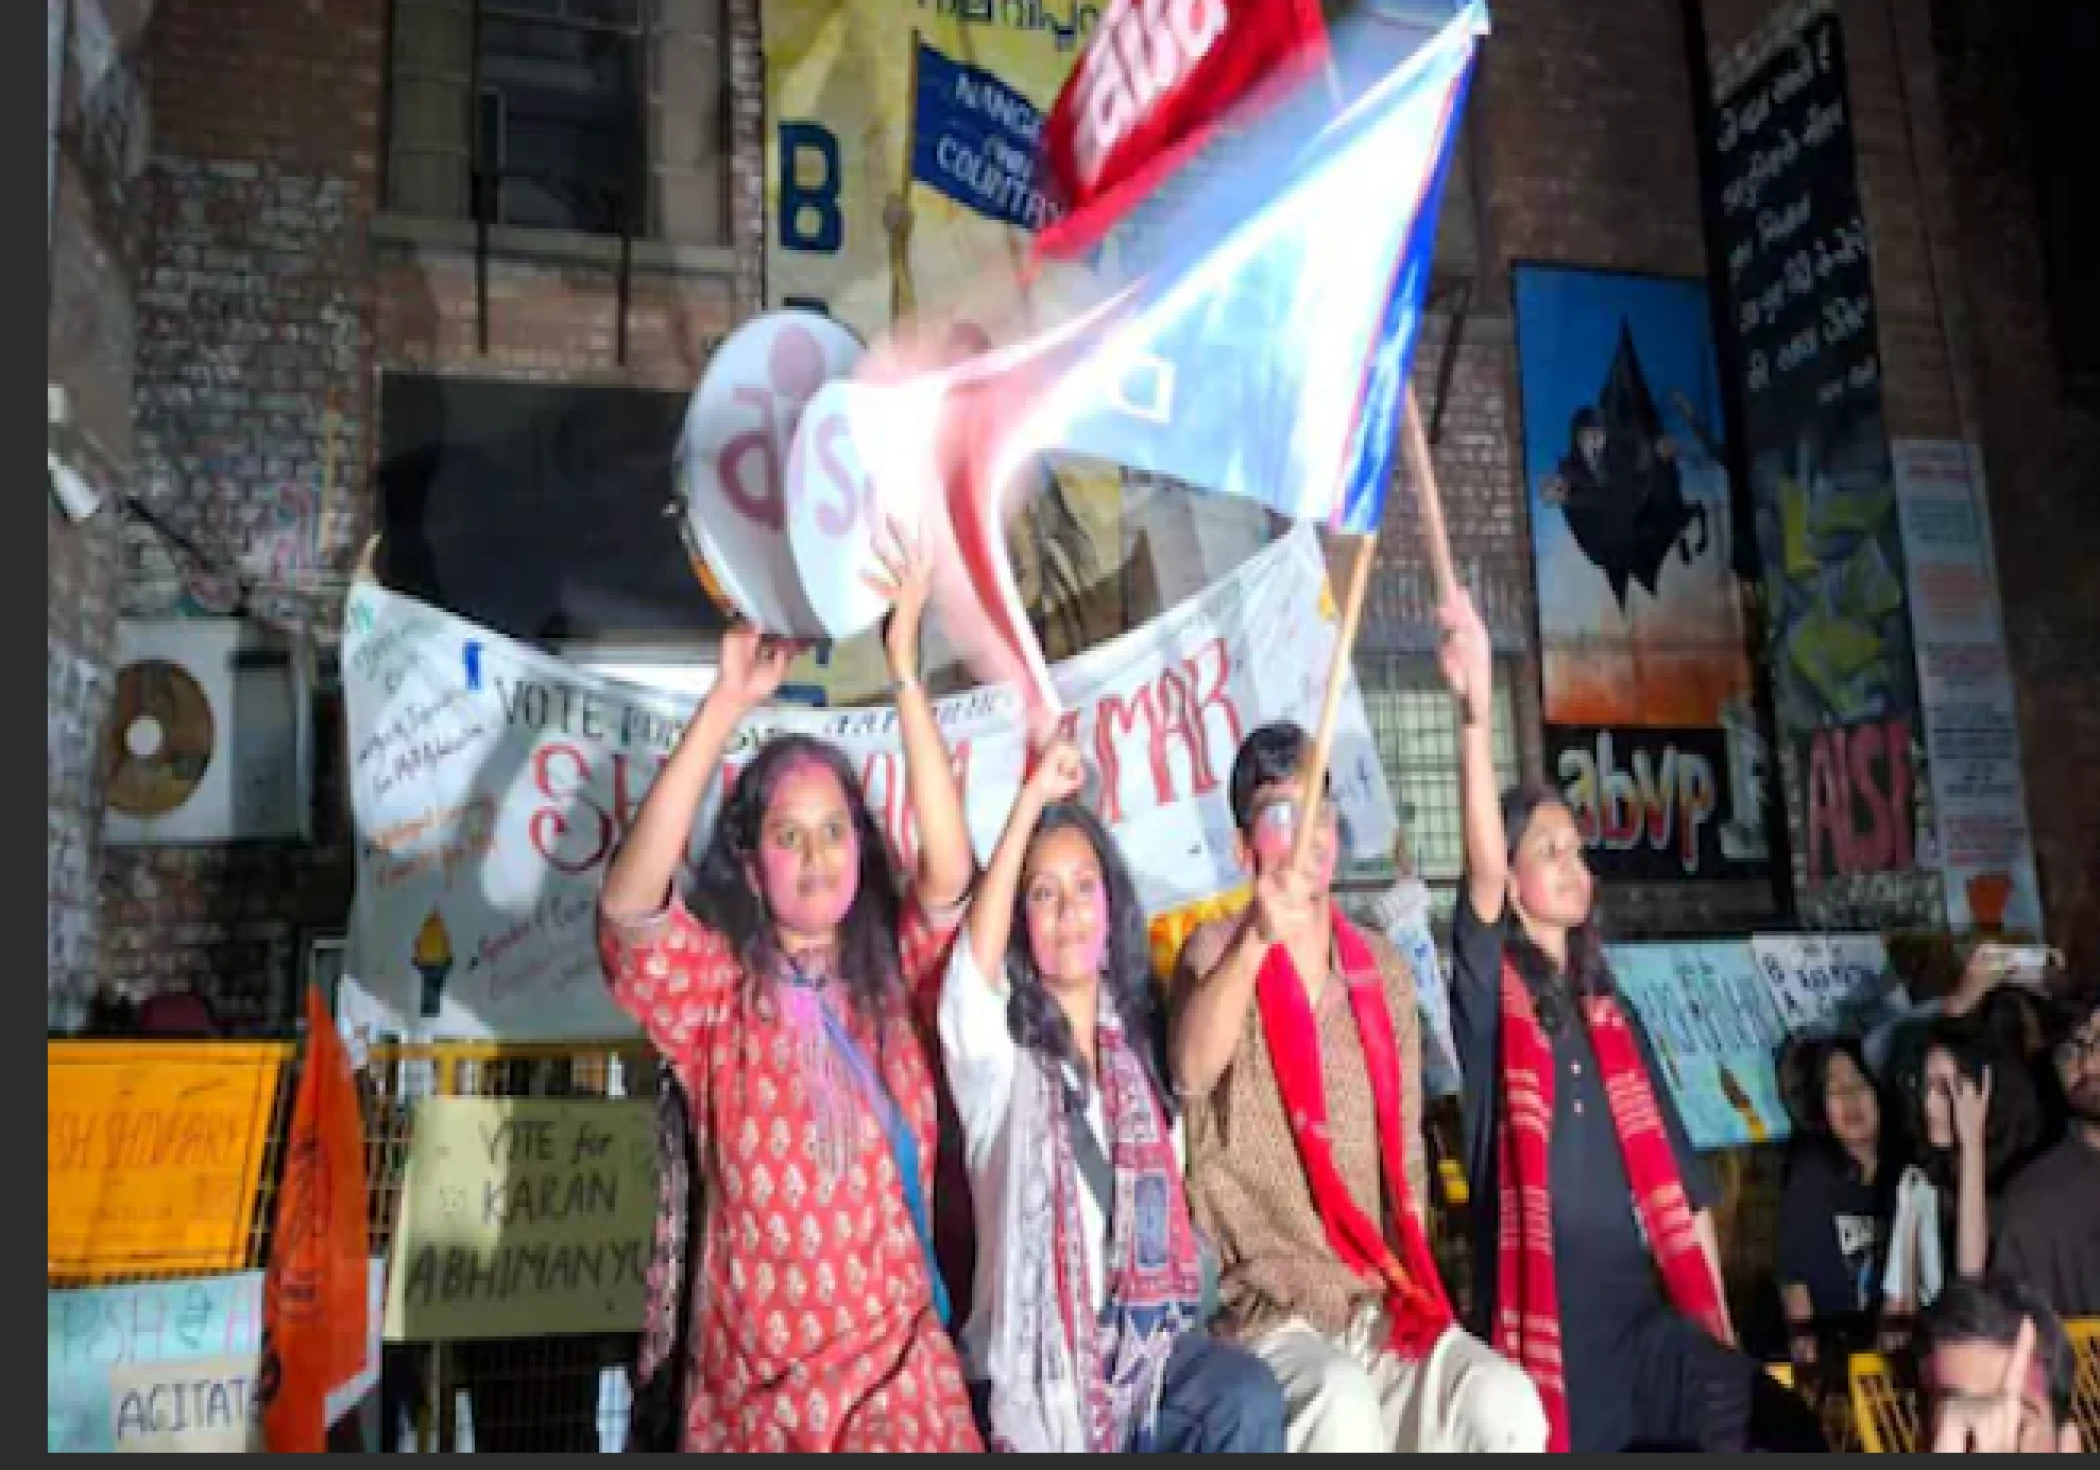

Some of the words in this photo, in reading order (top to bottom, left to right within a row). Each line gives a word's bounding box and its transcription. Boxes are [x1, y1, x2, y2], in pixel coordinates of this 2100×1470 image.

[493, 677, 604, 739] VOTE
[1557, 728, 1716, 875] abvp
[480, 1172, 618, 1226] KARAN
